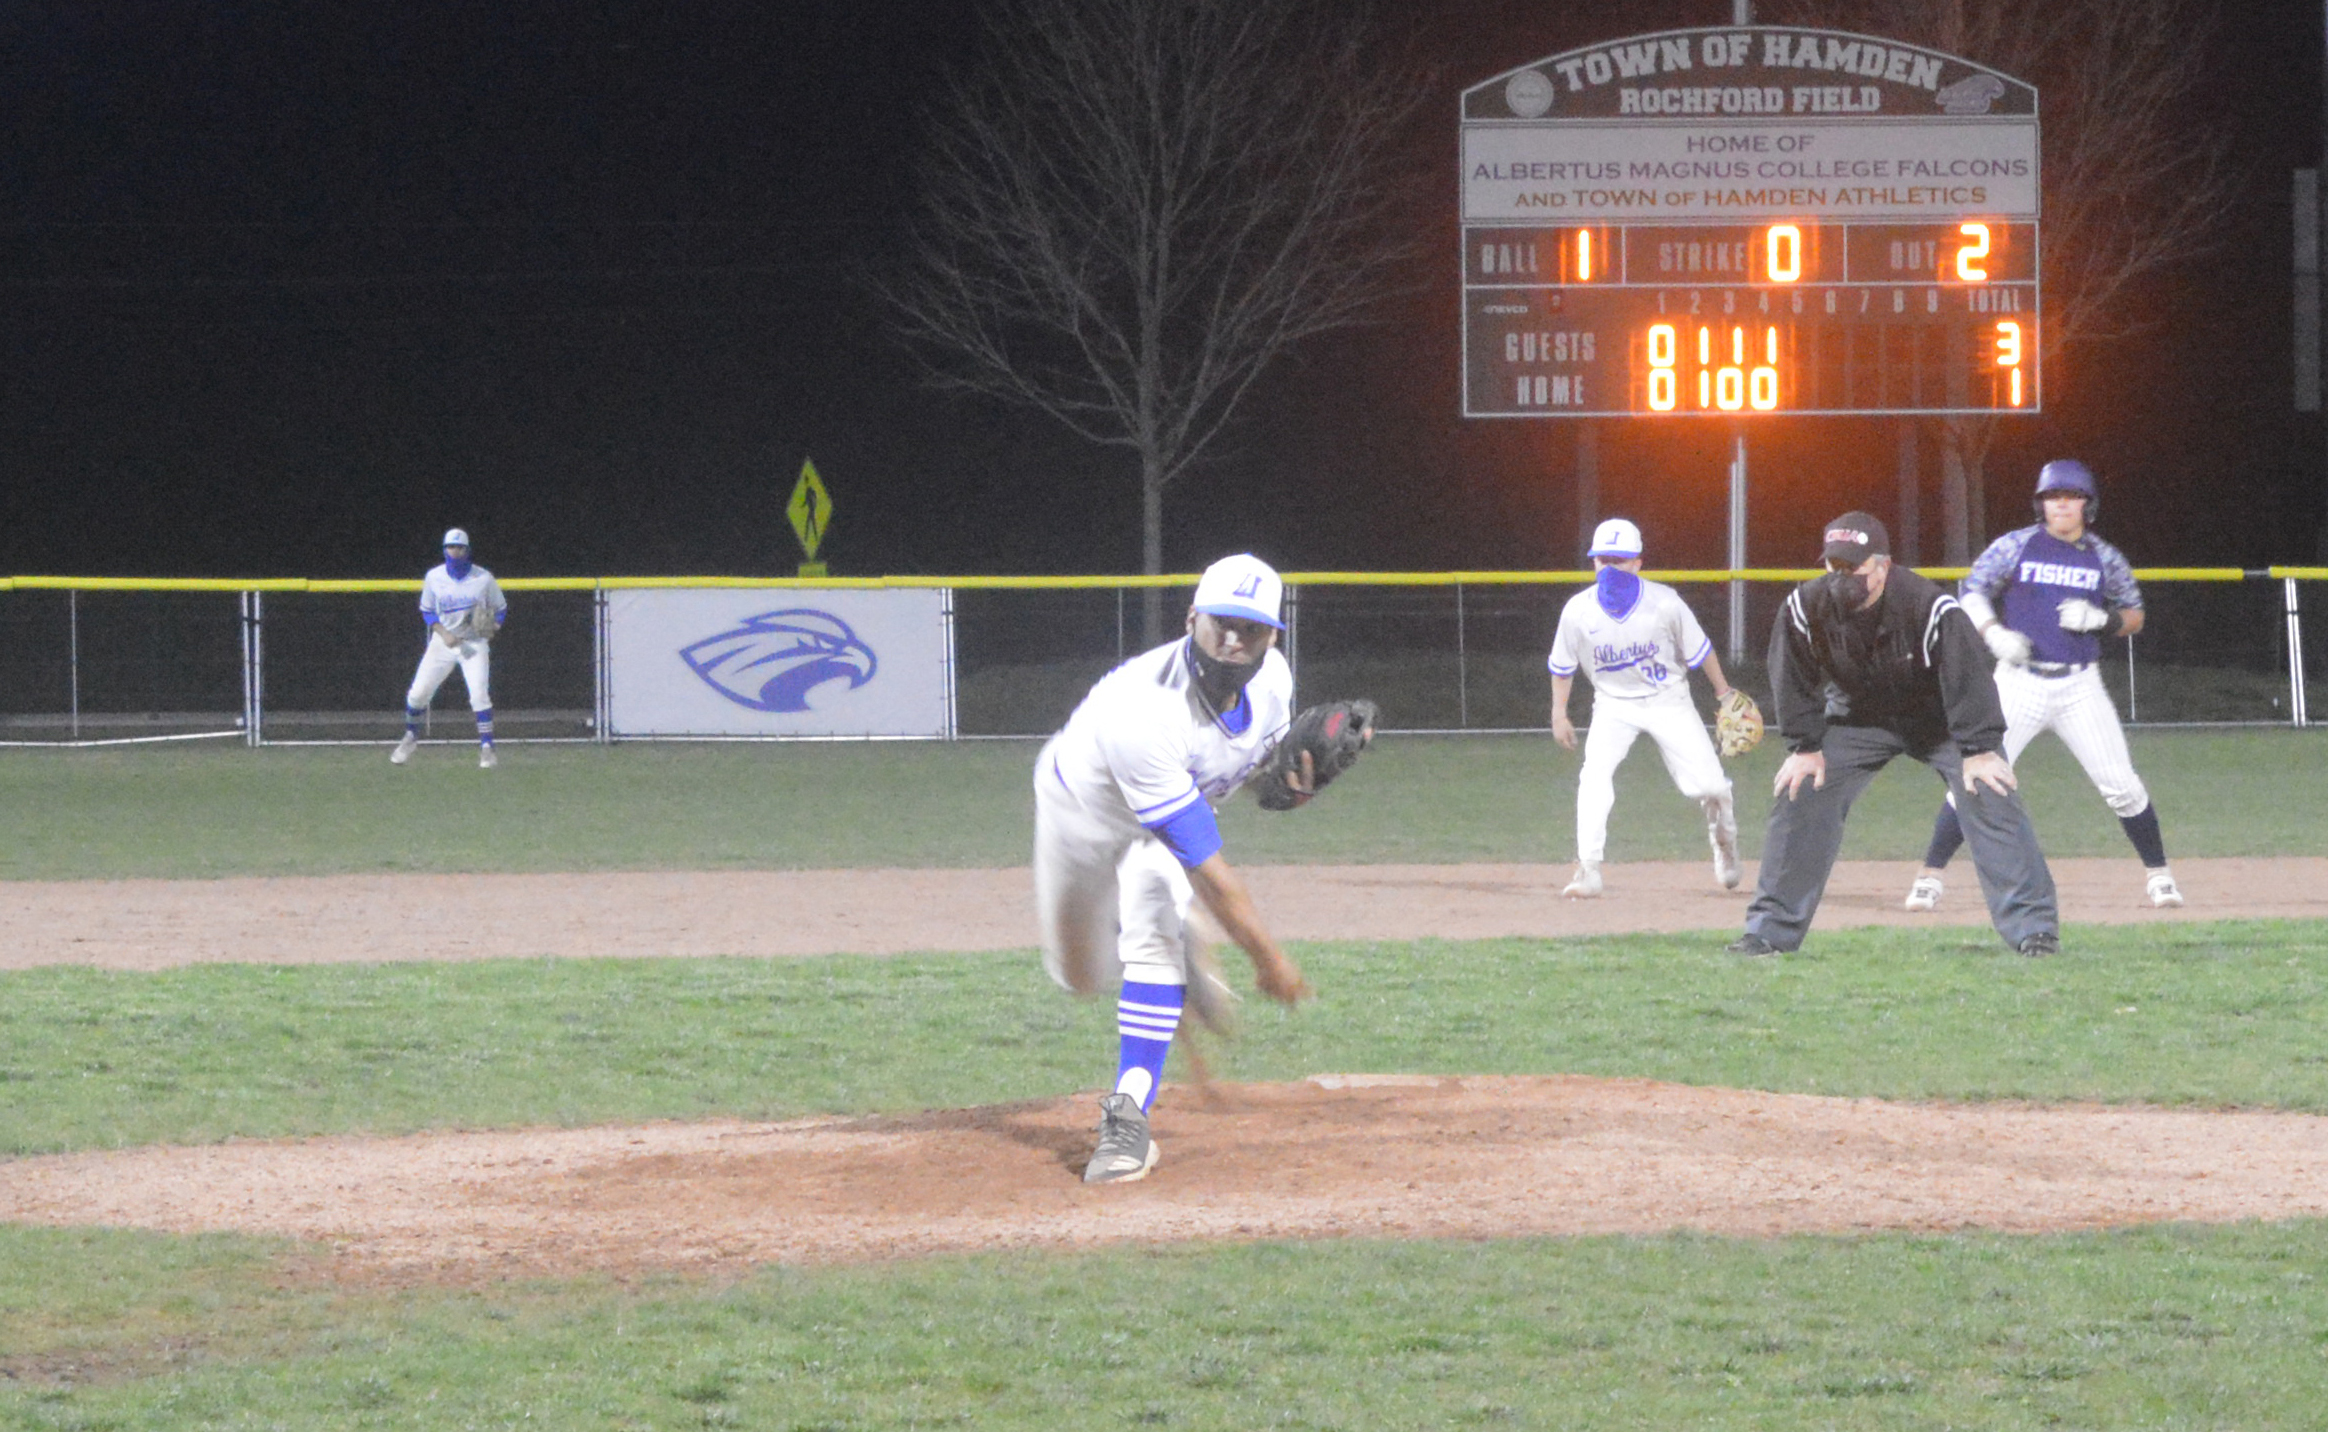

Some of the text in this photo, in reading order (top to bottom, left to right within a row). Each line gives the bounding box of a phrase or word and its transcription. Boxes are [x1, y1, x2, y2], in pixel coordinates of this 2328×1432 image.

[1556, 34, 1943, 91] TOWN OF HAMDEN
[1619, 86, 1881, 114] ROCHFORD FIELD
[1687, 135, 1815, 153] HOME OF
[1472, 159, 2029, 180] ALBERTUS MAGNUS COLLEGE FALCONS
[1514, 186, 1987, 207] AND TOWN OF HAMDEN ATHLETICS
[1481, 229, 1590, 281] BALL 1
[1659, 225, 1801, 282] STRIKE 0
[1890, 223, 1990, 281] OUT 2
[1657, 290, 1666, 315] 1
[1690, 290, 1701, 315] 2
[1724, 290, 1735, 315] 3
[1758, 290, 1770, 315] 4
[1860, 289, 1870, 314] 7
[1968, 289, 2020, 312] TOTAL
[1505, 332, 1596, 361] GUESTS
[1648, 324, 1675, 367] 0
[1996, 322, 2021, 365] 3
[1517, 376, 1584, 405] HOME
[1648, 367, 1676, 411] 0
[2011, 367, 2021, 406] 1
[2019, 560, 2101, 591] FISHER
